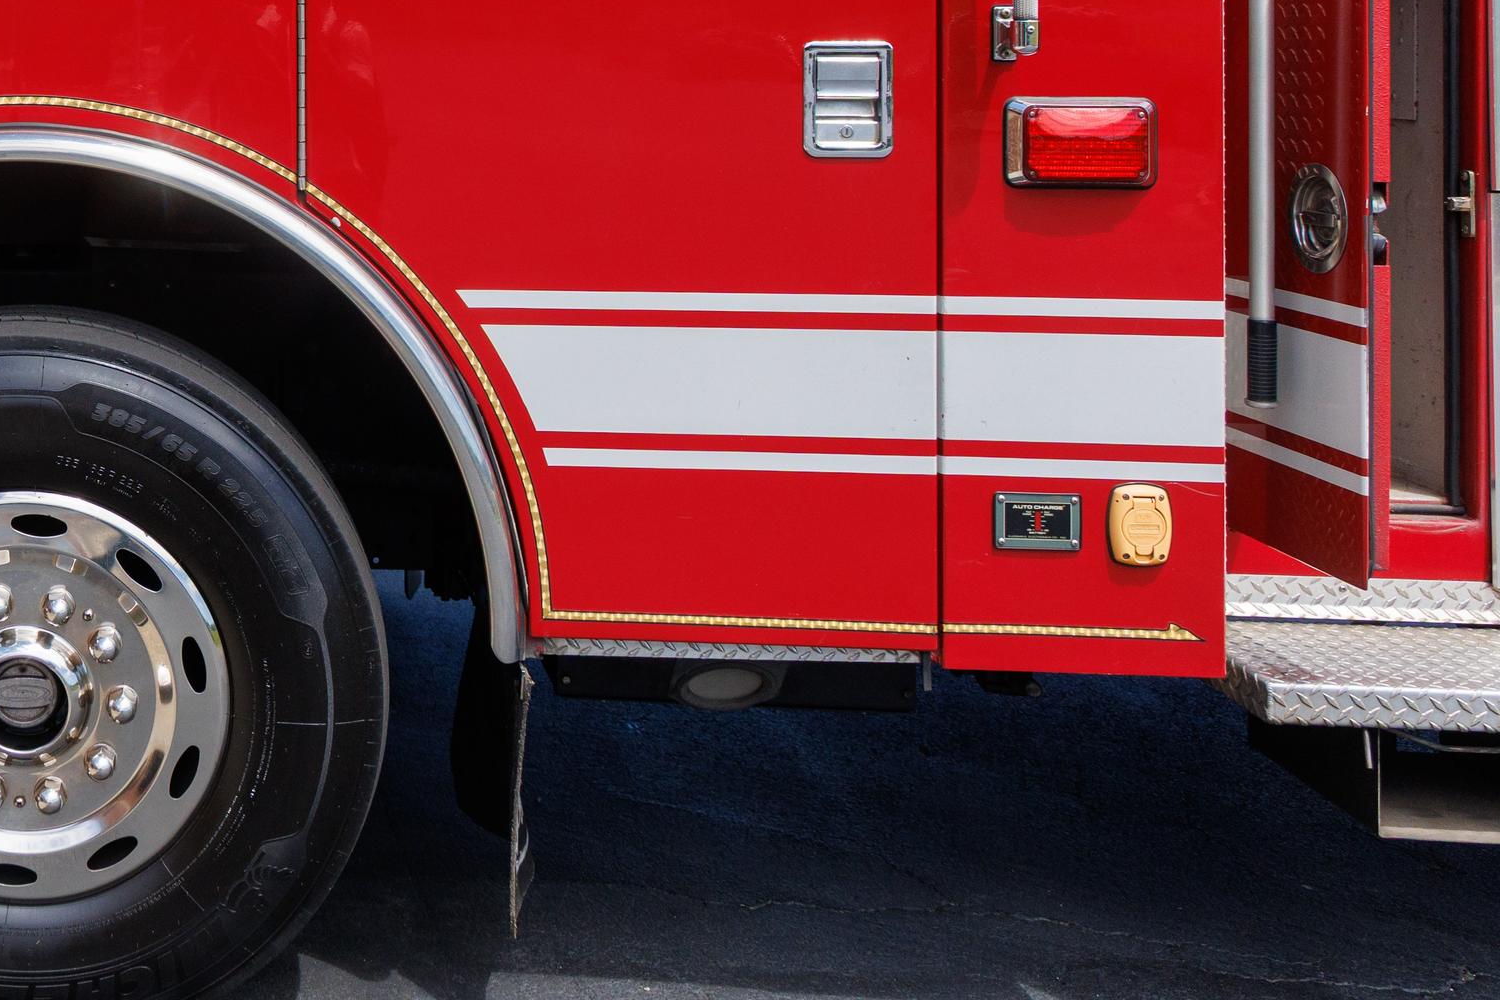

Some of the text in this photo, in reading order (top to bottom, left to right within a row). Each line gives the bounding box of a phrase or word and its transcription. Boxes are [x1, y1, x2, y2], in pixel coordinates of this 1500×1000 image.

[91, 402, 198, 461] 385/65
[196, 457, 221, 480] R
[219, 478, 268, 527] 22.5
